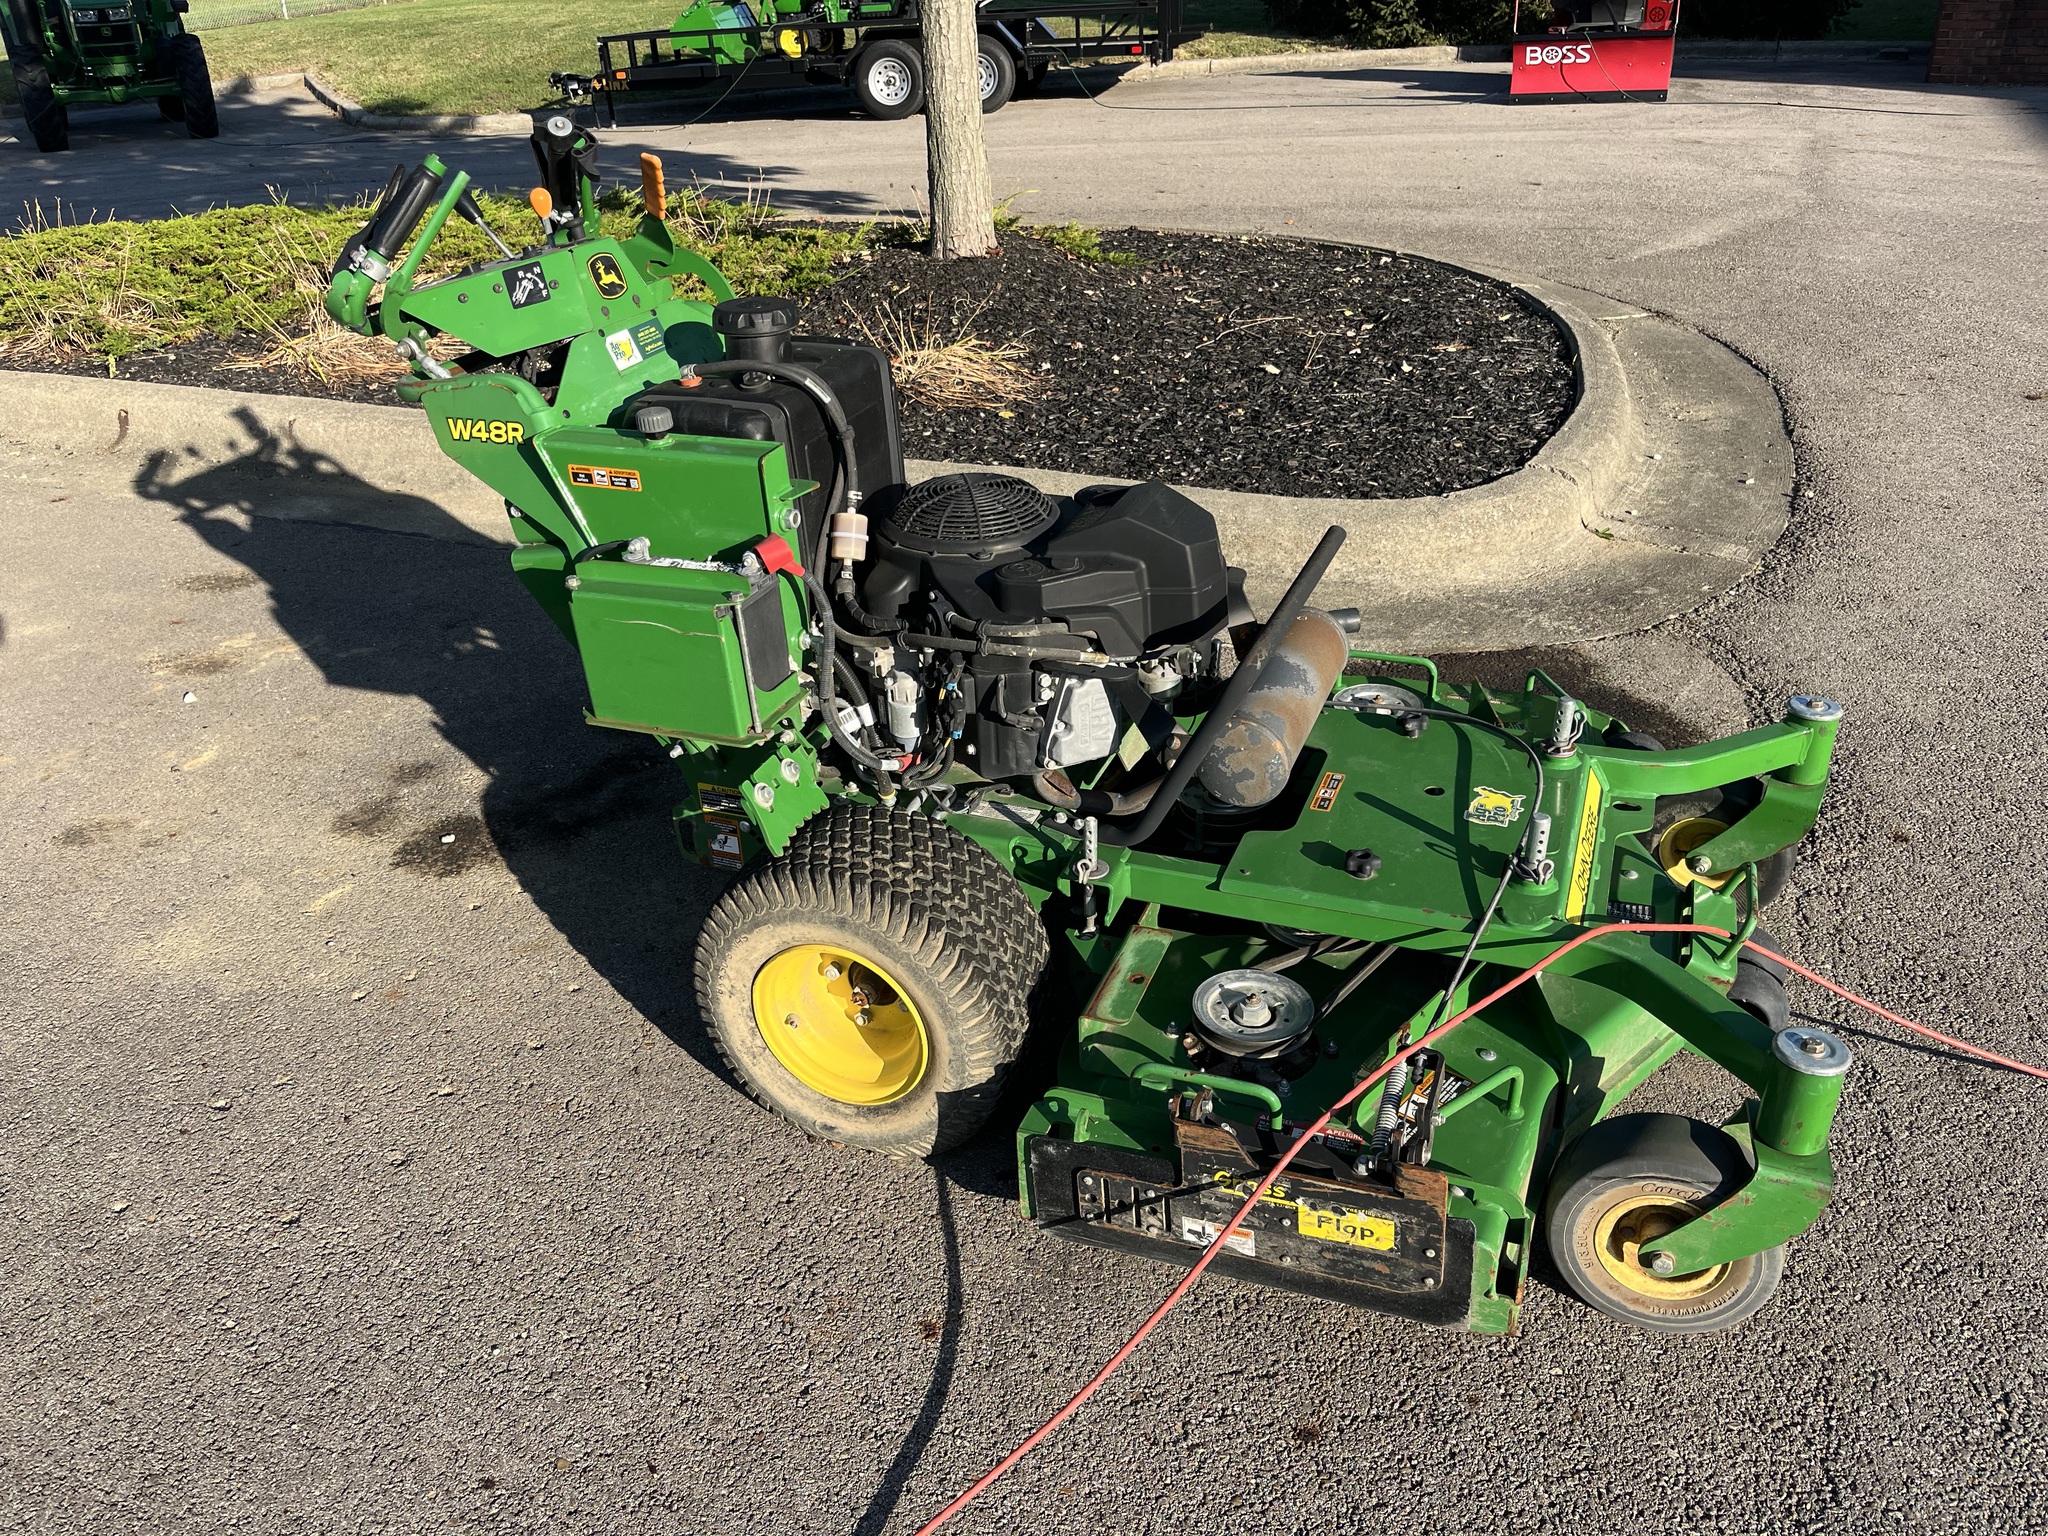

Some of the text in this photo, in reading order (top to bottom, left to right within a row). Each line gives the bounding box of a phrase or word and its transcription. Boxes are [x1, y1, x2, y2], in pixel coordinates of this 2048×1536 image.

[1525, 44, 1592, 66] BOSS
[517, 270, 525, 279] R
[533, 266, 541, 274] N
[541, 289, 548, 298] F
[446, 416, 525, 445] W48R
[1574, 805, 1598, 904] JOHN DEERE
[1317, 1215, 1375, 1241] Flap
